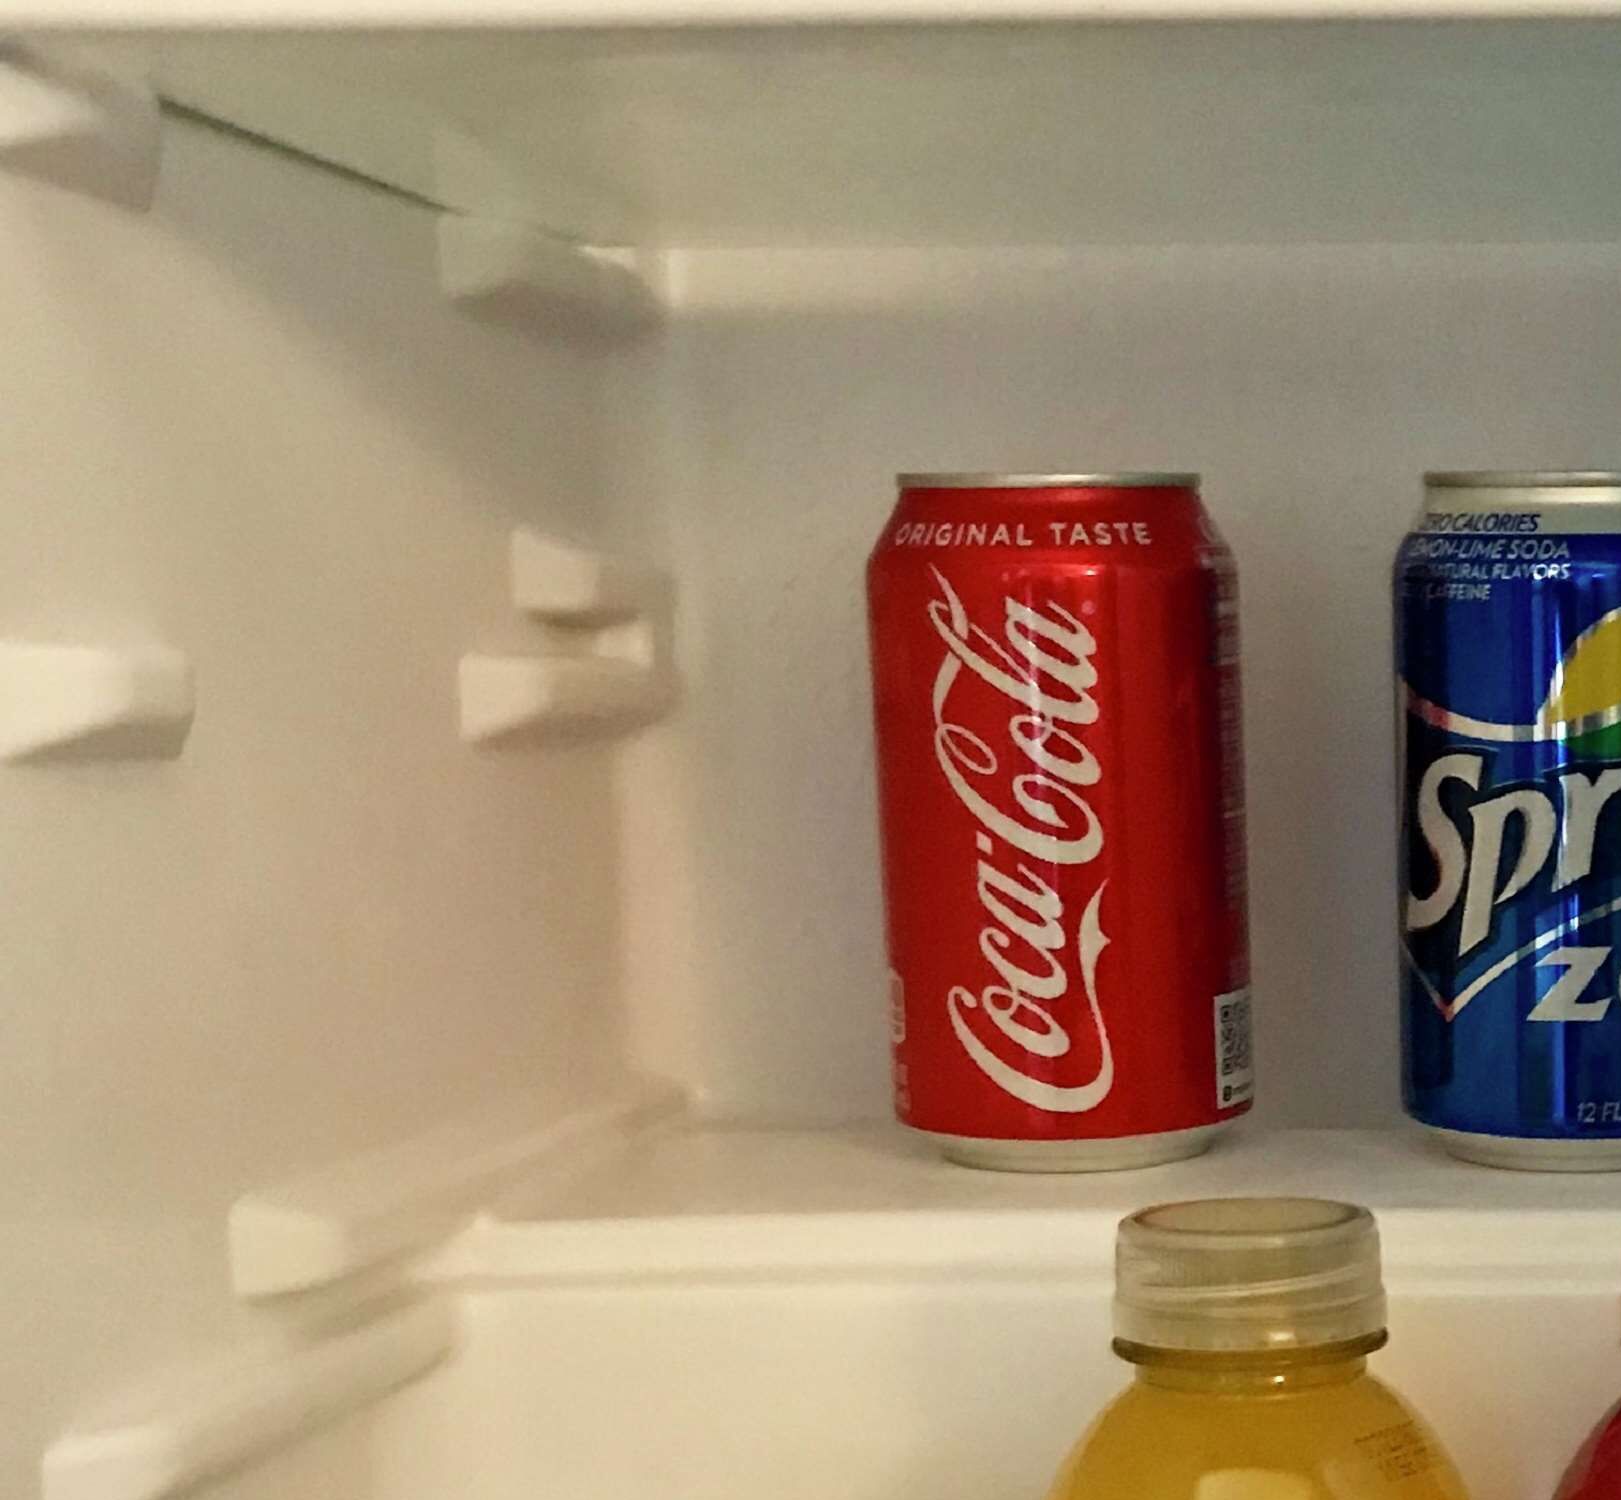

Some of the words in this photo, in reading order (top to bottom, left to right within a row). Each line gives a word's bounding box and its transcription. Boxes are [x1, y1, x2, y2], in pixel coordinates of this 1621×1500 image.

[1452, 513, 1541, 531] CALORIES
[895, 522, 1033, 546] ORIGINAL
[1050, 522, 1152, 546] TASTE
[1507, 539, 1571, 560] SODA
[1491, 562, 1571, 580] FLAVORS
[928, 563, 1114, 1114] Coca-Cola
[1577, 1101, 1595, 1124] 12
